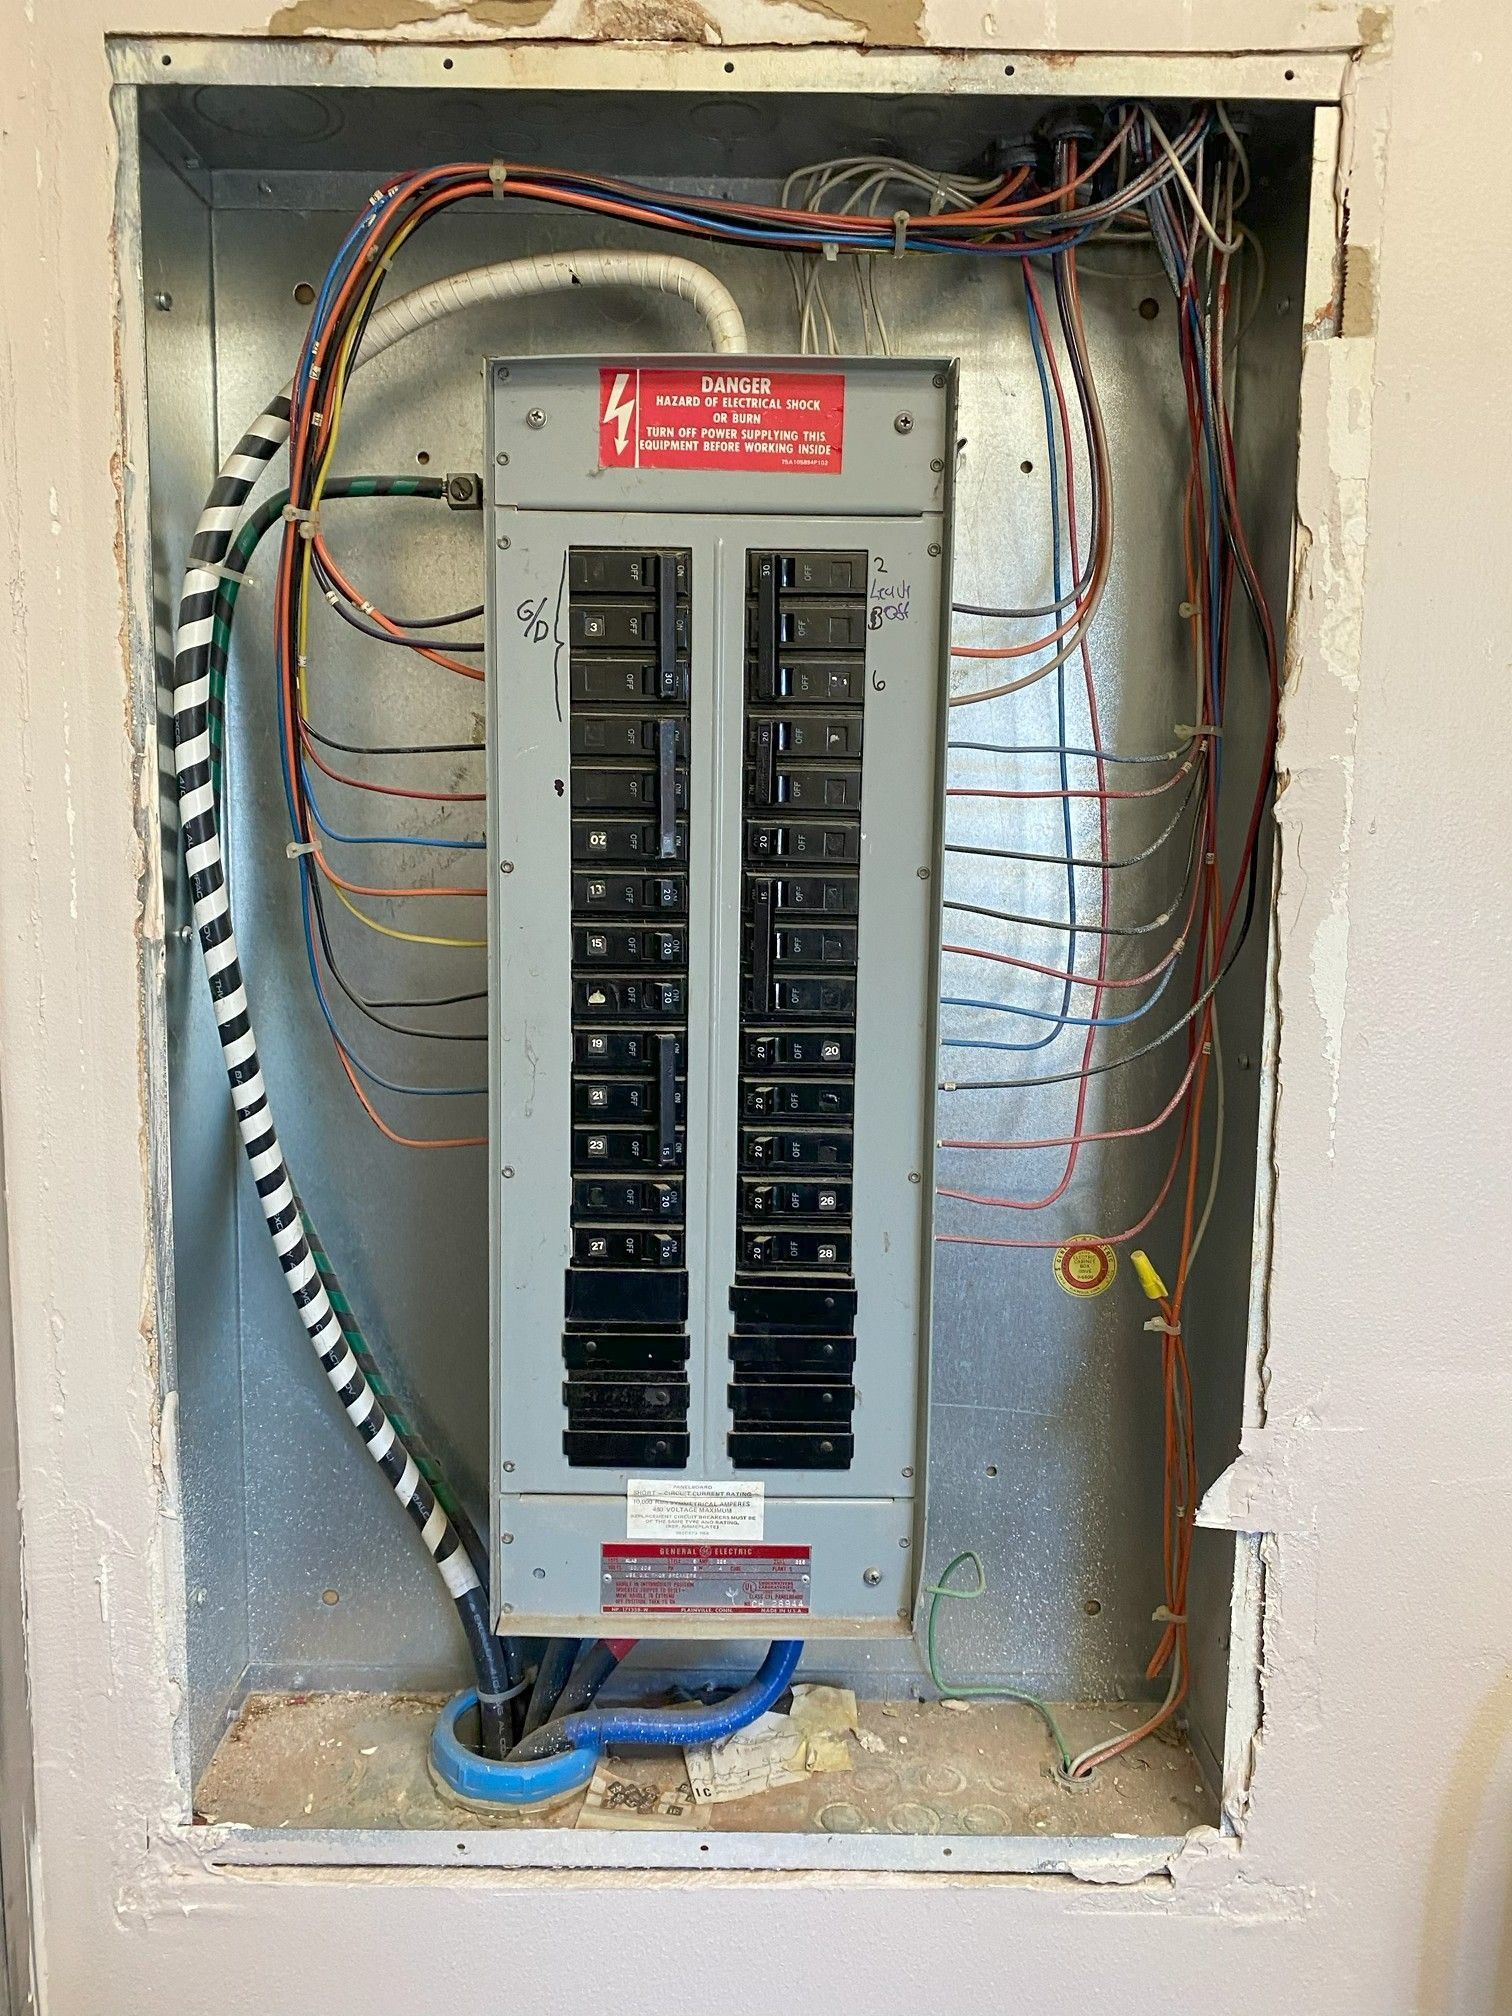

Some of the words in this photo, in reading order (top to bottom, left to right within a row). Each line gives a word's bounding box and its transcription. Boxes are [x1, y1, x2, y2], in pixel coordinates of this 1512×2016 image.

[701, 376, 771, 394] DANGER
[656, 396, 700, 407] HAZARD
[704, 397, 718, 408] OF
[722, 397, 782, 409] ELECTRICAL
[786, 399, 820, 411] SHOCK
[713, 412, 728, 423] OR
[732, 413, 761, 424] BURN
[646, 427, 674, 437] TURN
[678, 427, 697, 438] OFF
[701, 428, 737, 439] POWER
[741, 429, 798, 441] SUPPLYING
[803, 431, 826, 442] THIS
[639, 440, 699, 451] EQUIPMENT
[703, 441, 740, 453] BEFORE
[744, 442, 794, 454] WORKING
[798, 443, 831, 455] INSIDE
[677, 565, 685, 577] ON
[763, 564, 770, 576] 30
[874, 557, 888, 573] 2
[630, 563, 639, 581] OFF
[804, 565, 812, 581] OFF
[590, 622, 598, 632] 3
[630, 618, 638, 635] OFF
[798, 620, 806, 636] OFF
[626, 673, 634, 690] OFF
[664, 672, 673, 685] 30
[801, 675, 809, 691] OFF
[872, 670, 887, 692] 6
[627, 728, 635, 745] OFF
[762, 731, 769, 742] 20
[795, 728, 803, 744] OFF
[630, 833, 638, 850] OFF
[760, 835, 768, 848] 20
[798, 834, 806, 851] OFF
[590, 885, 602, 895] 13
[626, 887, 634, 904] OFF
[664, 889, 671, 901] 20
[591, 939, 602, 947] 15
[628, 938, 636, 953] OFF
[664, 942, 671, 954] 20
[627, 987, 635, 1003] OFF
[664, 992, 671, 1004] 20
[791, 988, 799, 1003] OFF
[592, 1039, 602, 1048] 19
[757, 1046, 765, 1058] 20
[793, 1043, 802, 1059] OFF
[825, 1046, 839, 1055] 20
[592, 1091, 603, 1100] 21
[791, 1092, 799, 1109] OFF
[756, 1097, 763, 1109] 20
[590, 1141, 603, 1149] 23
[755, 1145, 763, 1157] 20
[662, 1196, 670, 1208] 20
[755, 1197, 762, 1209] 20
[820, 1196, 835, 1206] 26
[591, 1242, 604, 1251] 27
[626, 1238, 634, 1254] OFF
[663, 1247, 670, 1258] 20
[791, 1241, 799, 1257] OFF
[754, 1248, 761, 1259] 20
[819, 1249, 833, 1258] 28
